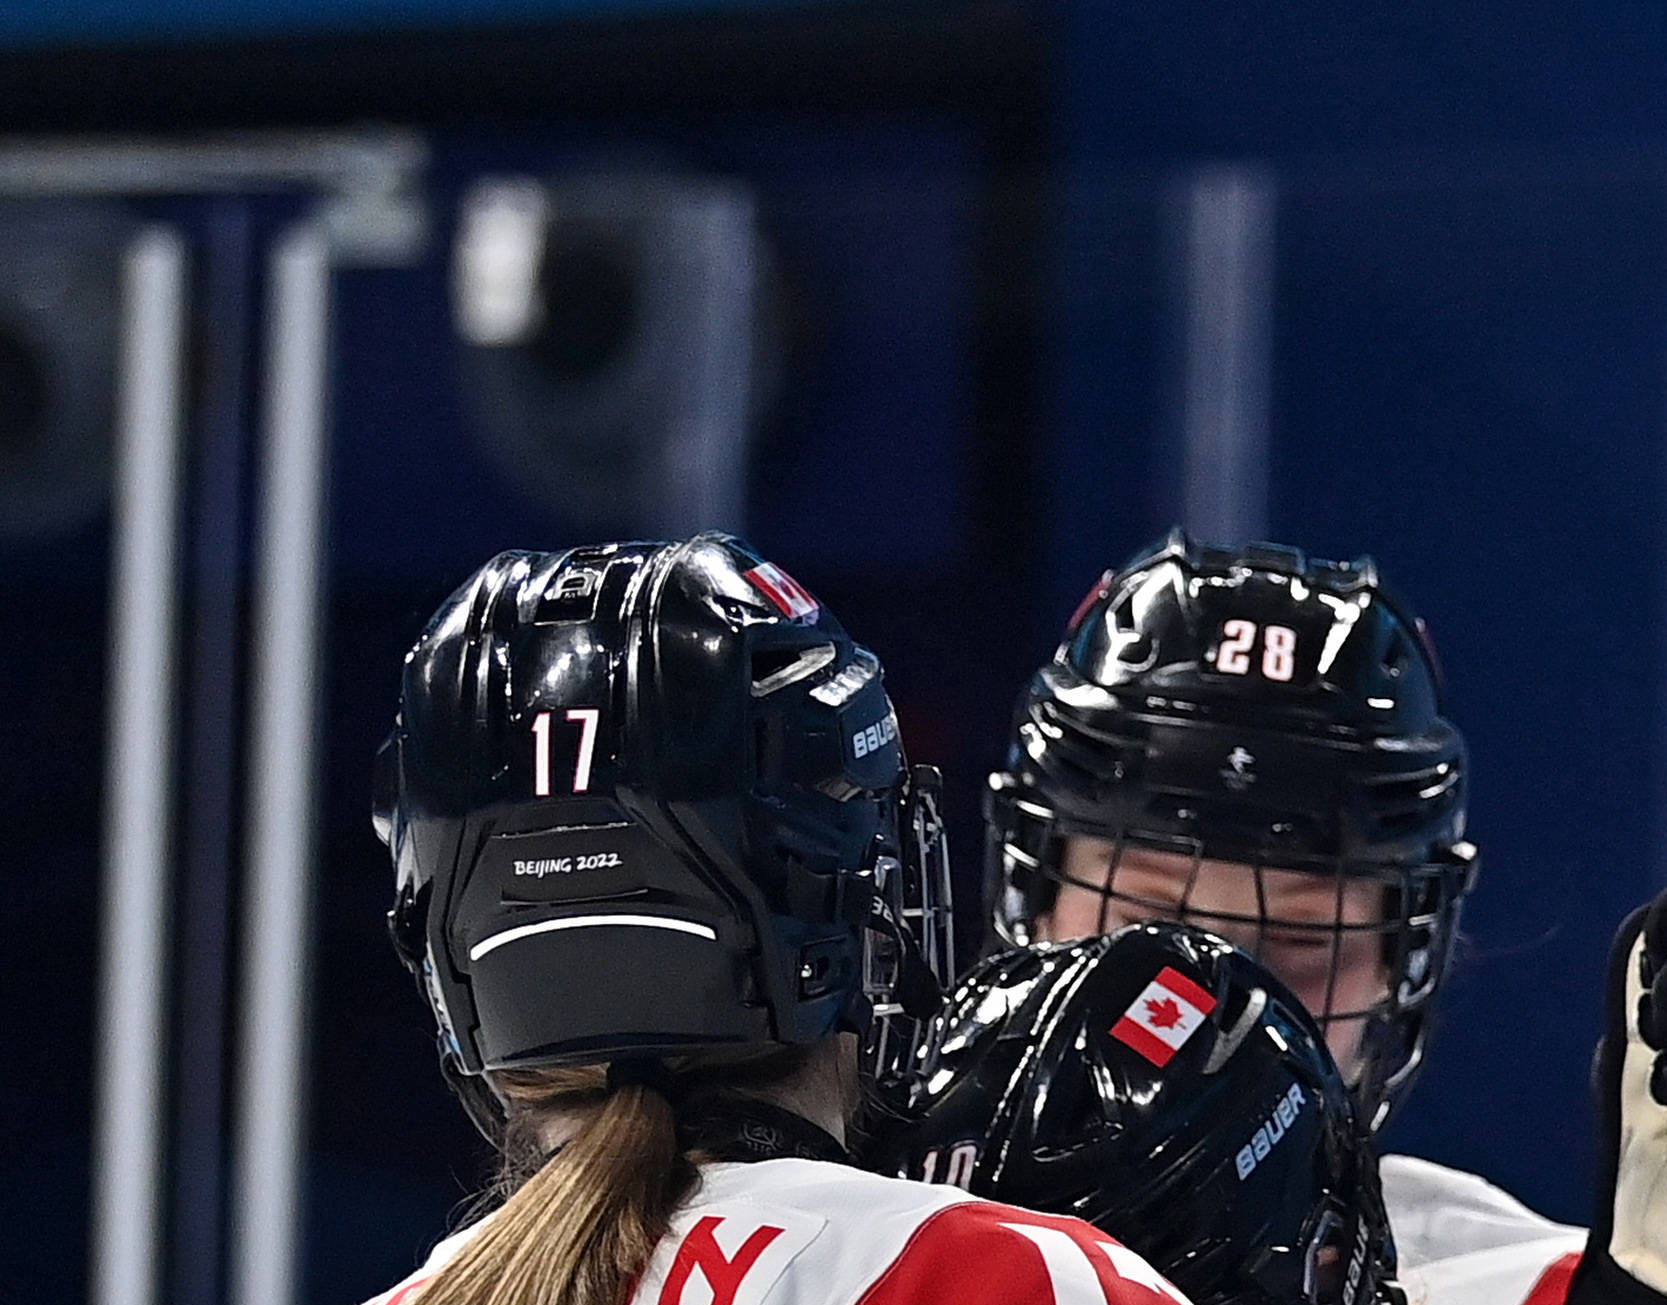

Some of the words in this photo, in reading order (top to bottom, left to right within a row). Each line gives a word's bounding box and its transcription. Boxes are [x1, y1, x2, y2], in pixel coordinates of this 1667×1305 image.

[1216, 619, 1297, 682] 28
[531, 708, 600, 797] 17
[513, 857, 572, 878] BEIJING
[576, 852, 623, 870] 2022
[1235, 1082, 1306, 1181] BAUER
[922, 1143, 979, 1192] 10
